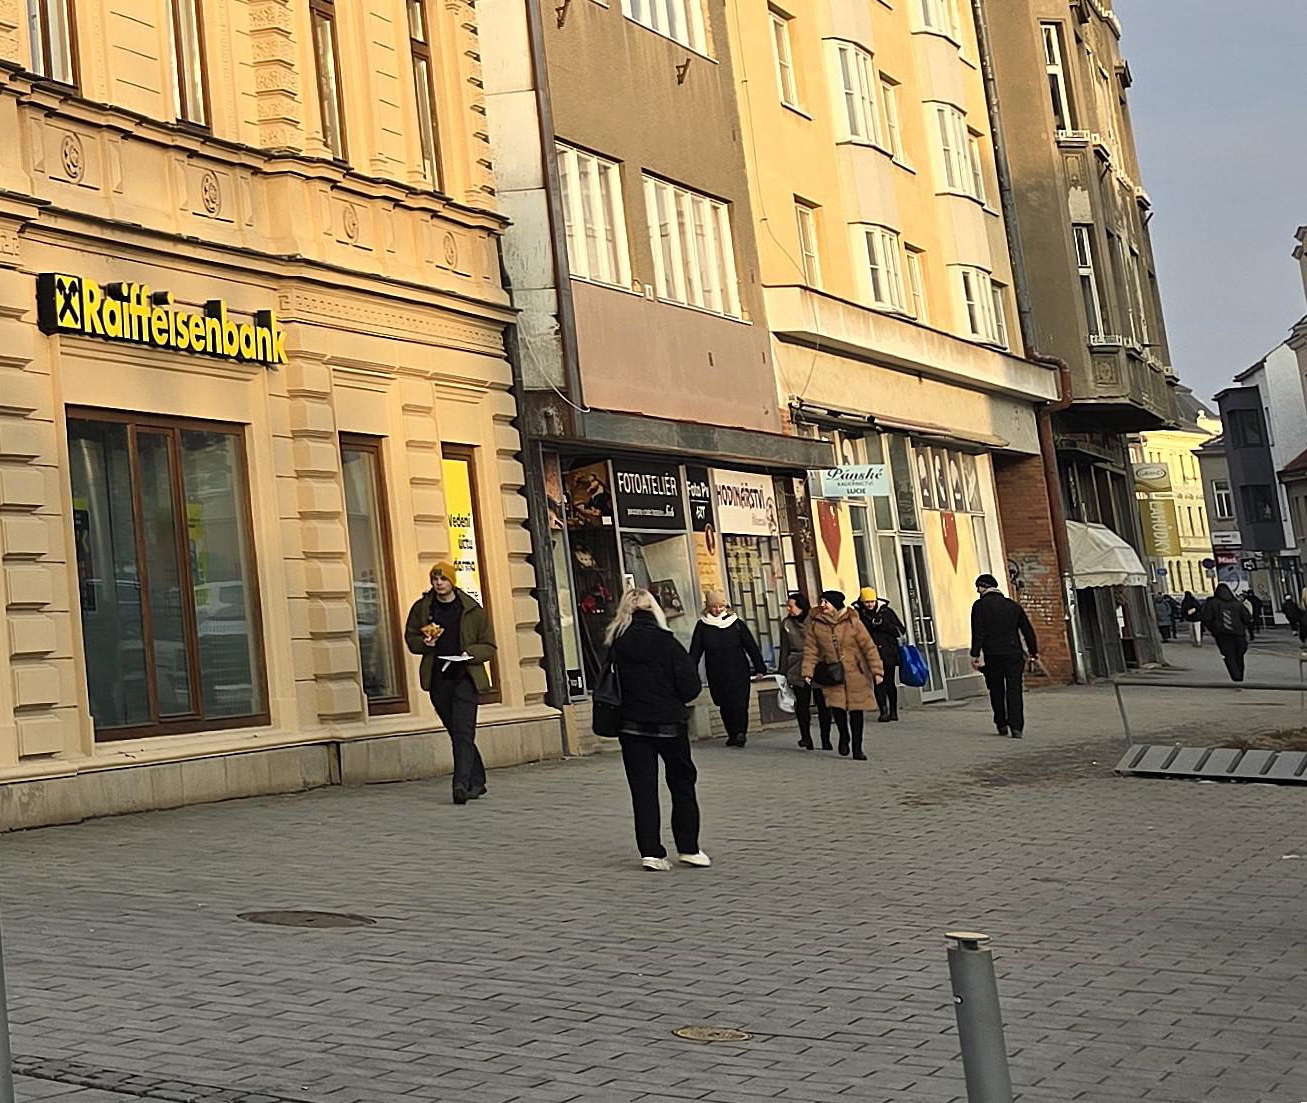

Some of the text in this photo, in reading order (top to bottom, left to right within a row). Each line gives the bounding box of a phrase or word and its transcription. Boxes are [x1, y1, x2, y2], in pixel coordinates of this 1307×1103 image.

[82, 278, 289, 365] Raiffeisenbank
[617, 472, 677, 496] FOTOATELIÉR
[827, 468, 883, 480] Pánské
[686, 481, 701, 497] Foto
[716, 482, 765, 509] HODINÁŘSTVÍ
[449, 513, 471, 527] Vedení
[1149, 501, 1172, 555] LAHŮDKY
